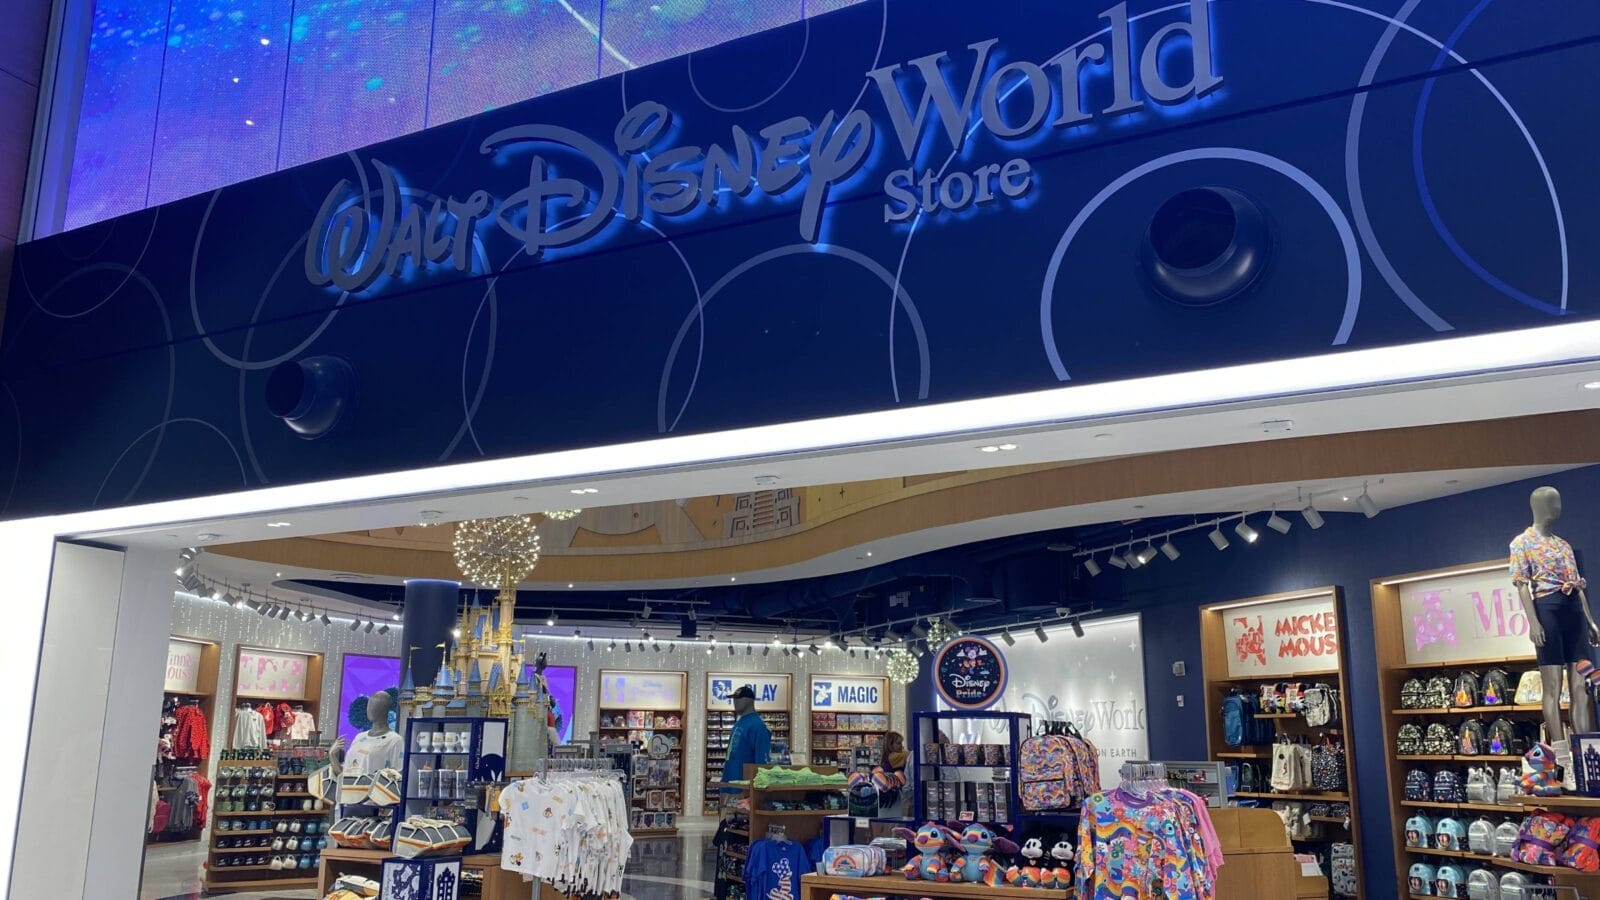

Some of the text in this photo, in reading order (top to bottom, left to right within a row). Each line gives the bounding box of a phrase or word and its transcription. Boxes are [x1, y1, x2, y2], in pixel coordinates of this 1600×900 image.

[865, 0, 1224, 162] World
[884, 157, 1031, 223] Store
[1274, 611, 1337, 637] MICKE
[1278, 633, 1338, 658] MOUS
[949, 673, 990, 692] Disney
[956, 688, 982, 698] Pride
[837, 686, 878, 704] MAGIC
[1110, 748, 1137, 757] EARTH
